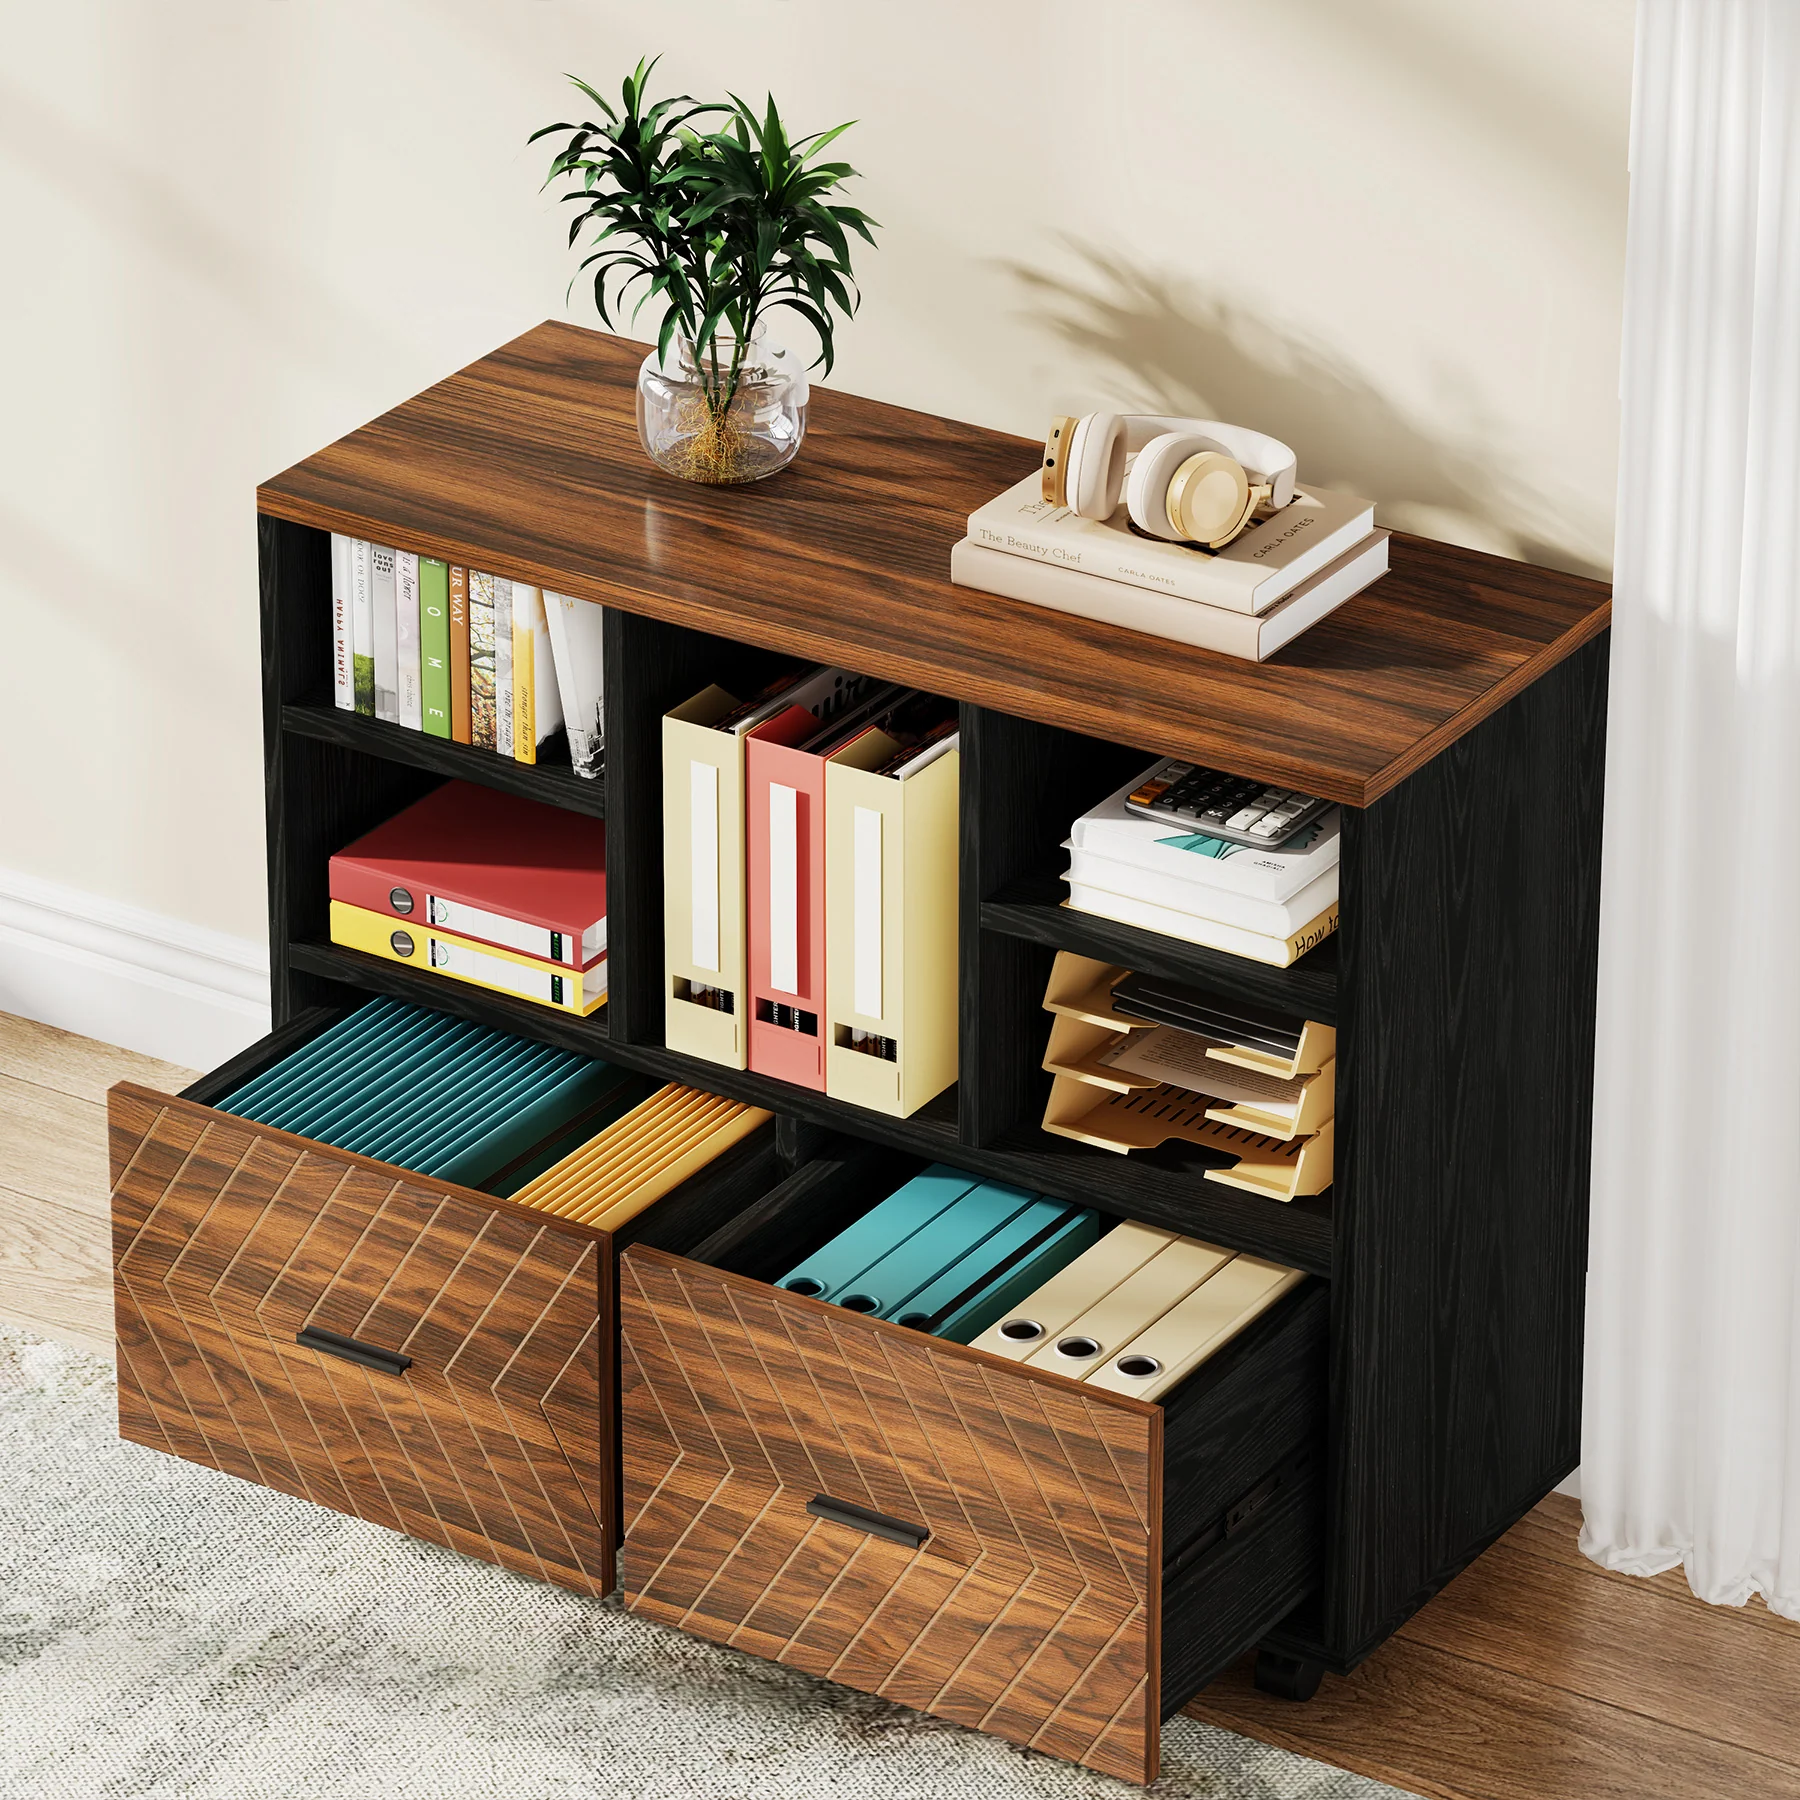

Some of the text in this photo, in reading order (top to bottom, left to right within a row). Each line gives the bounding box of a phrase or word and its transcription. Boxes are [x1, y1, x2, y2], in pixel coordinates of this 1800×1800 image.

[1018, 500, 1048, 515] The
[979, 528, 1082, 564] The Beauty Chef
[1253, 517, 1314, 559] CARLA OATES
[373, 551, 393, 562] love
[373, 559, 394, 568] runs
[376, 565, 391, 573] out
[1118, 566, 1176, 586] CARLA OATES
[452, 594, 463, 626] WAY
[519, 686, 532, 756] stronger than sin
[1294, 925, 1325, 957] How
